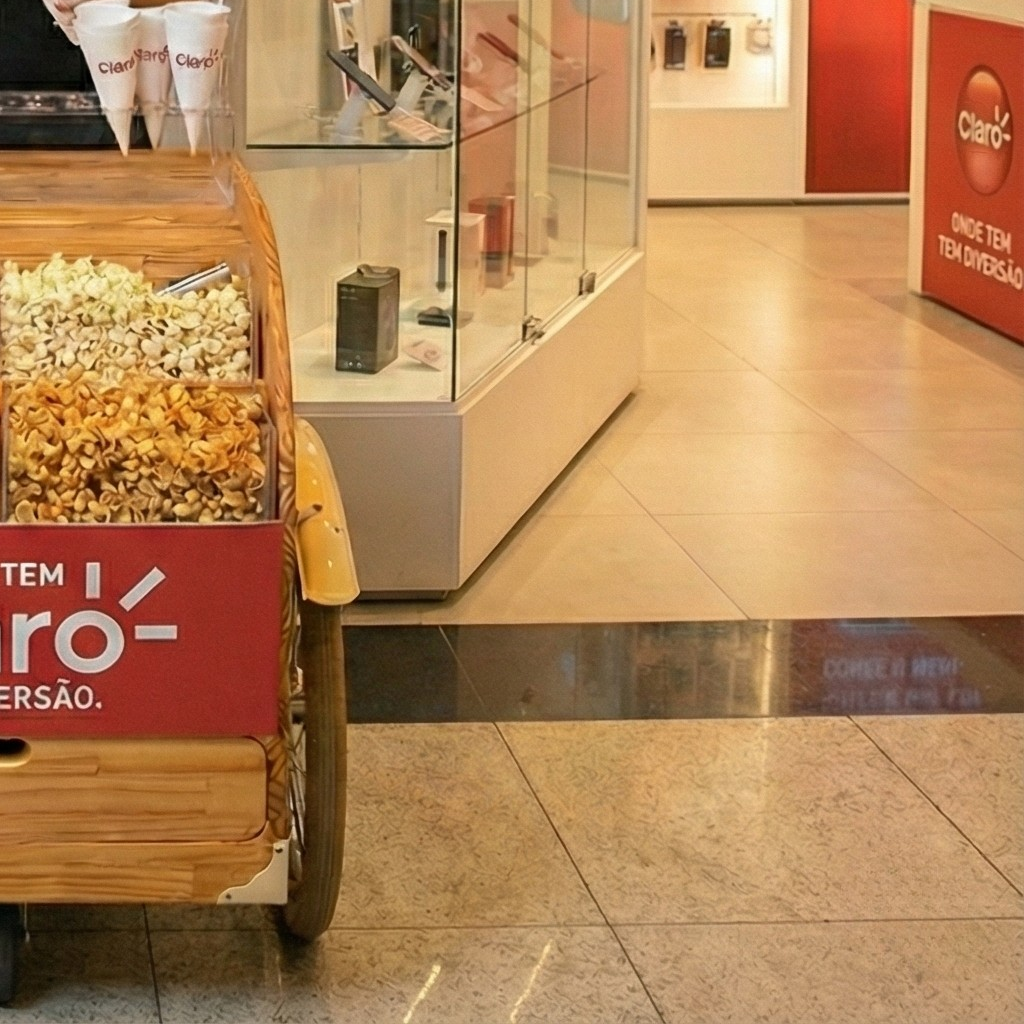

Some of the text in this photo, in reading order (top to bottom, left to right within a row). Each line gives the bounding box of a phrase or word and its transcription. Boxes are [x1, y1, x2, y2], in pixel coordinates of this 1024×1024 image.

[958, 110, 1003, 150] Claro
[938, 234, 962, 263] TEM
[951, 211, 1012, 255] ONDE TEM
[0, 562, 64, 587] TEM
